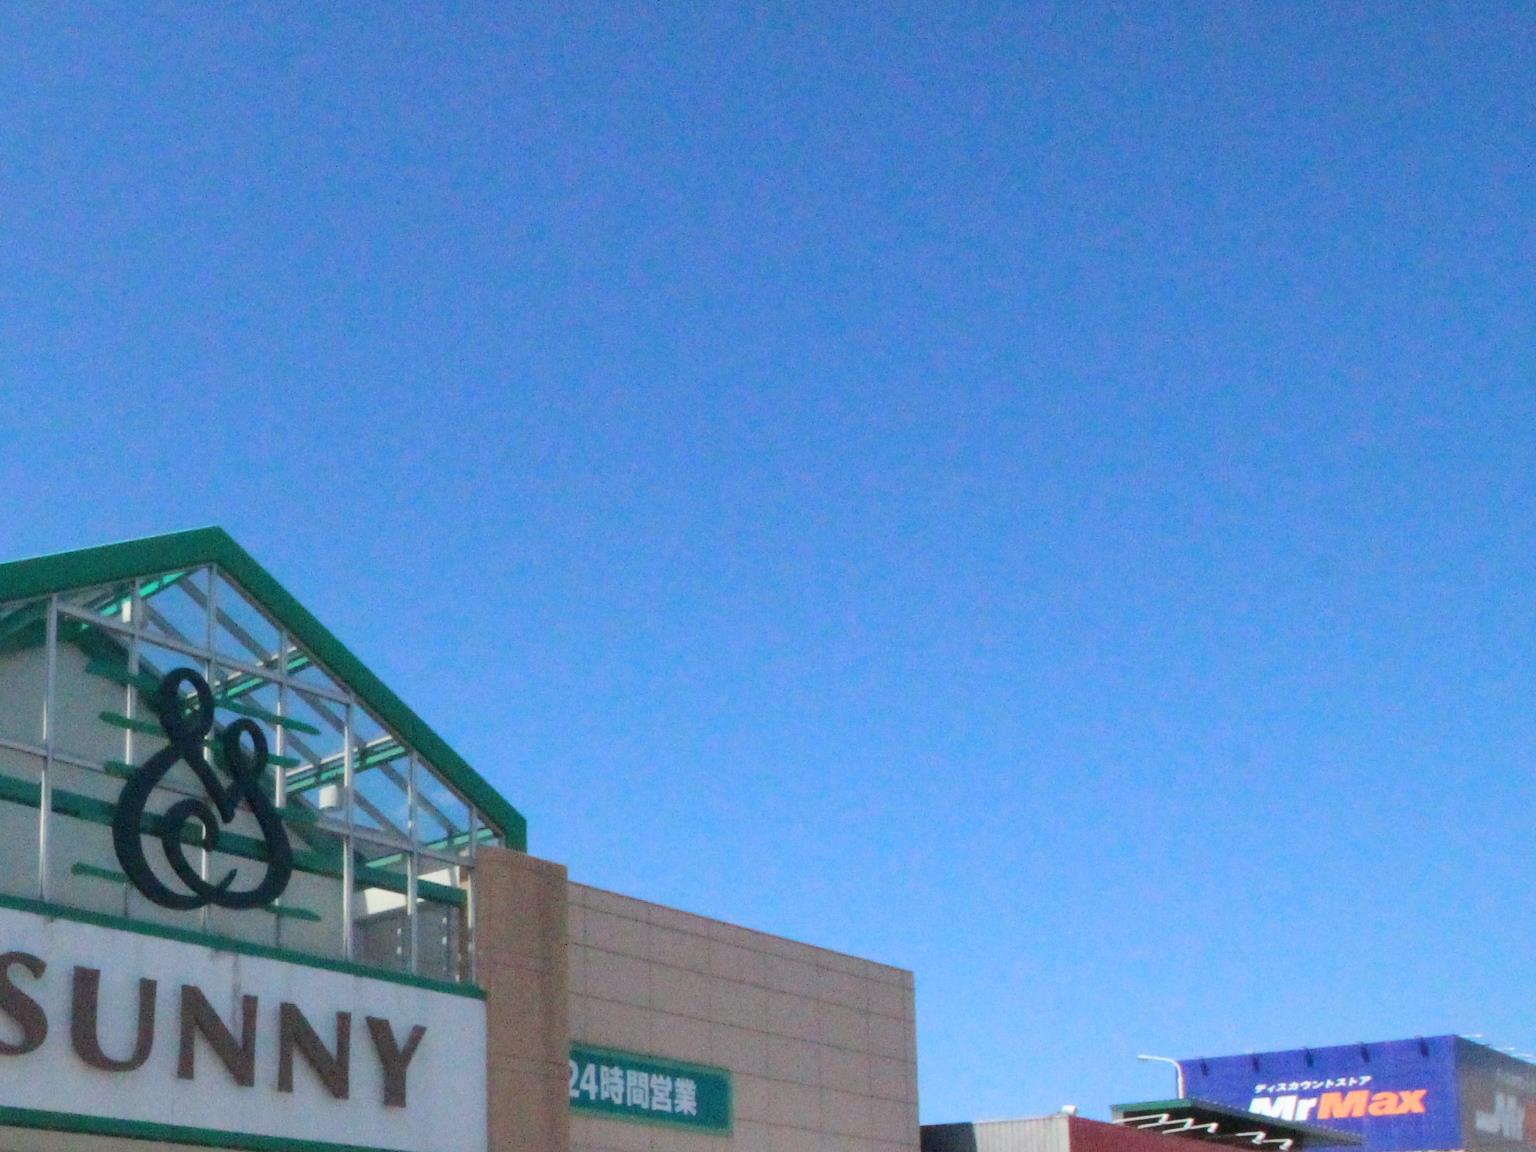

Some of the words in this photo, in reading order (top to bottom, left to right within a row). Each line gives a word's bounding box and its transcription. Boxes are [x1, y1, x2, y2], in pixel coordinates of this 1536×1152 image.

[569, 1059, 696, 1116] 24時間営業
[1254, 1075, 1373, 1094] ディスカウントストア
